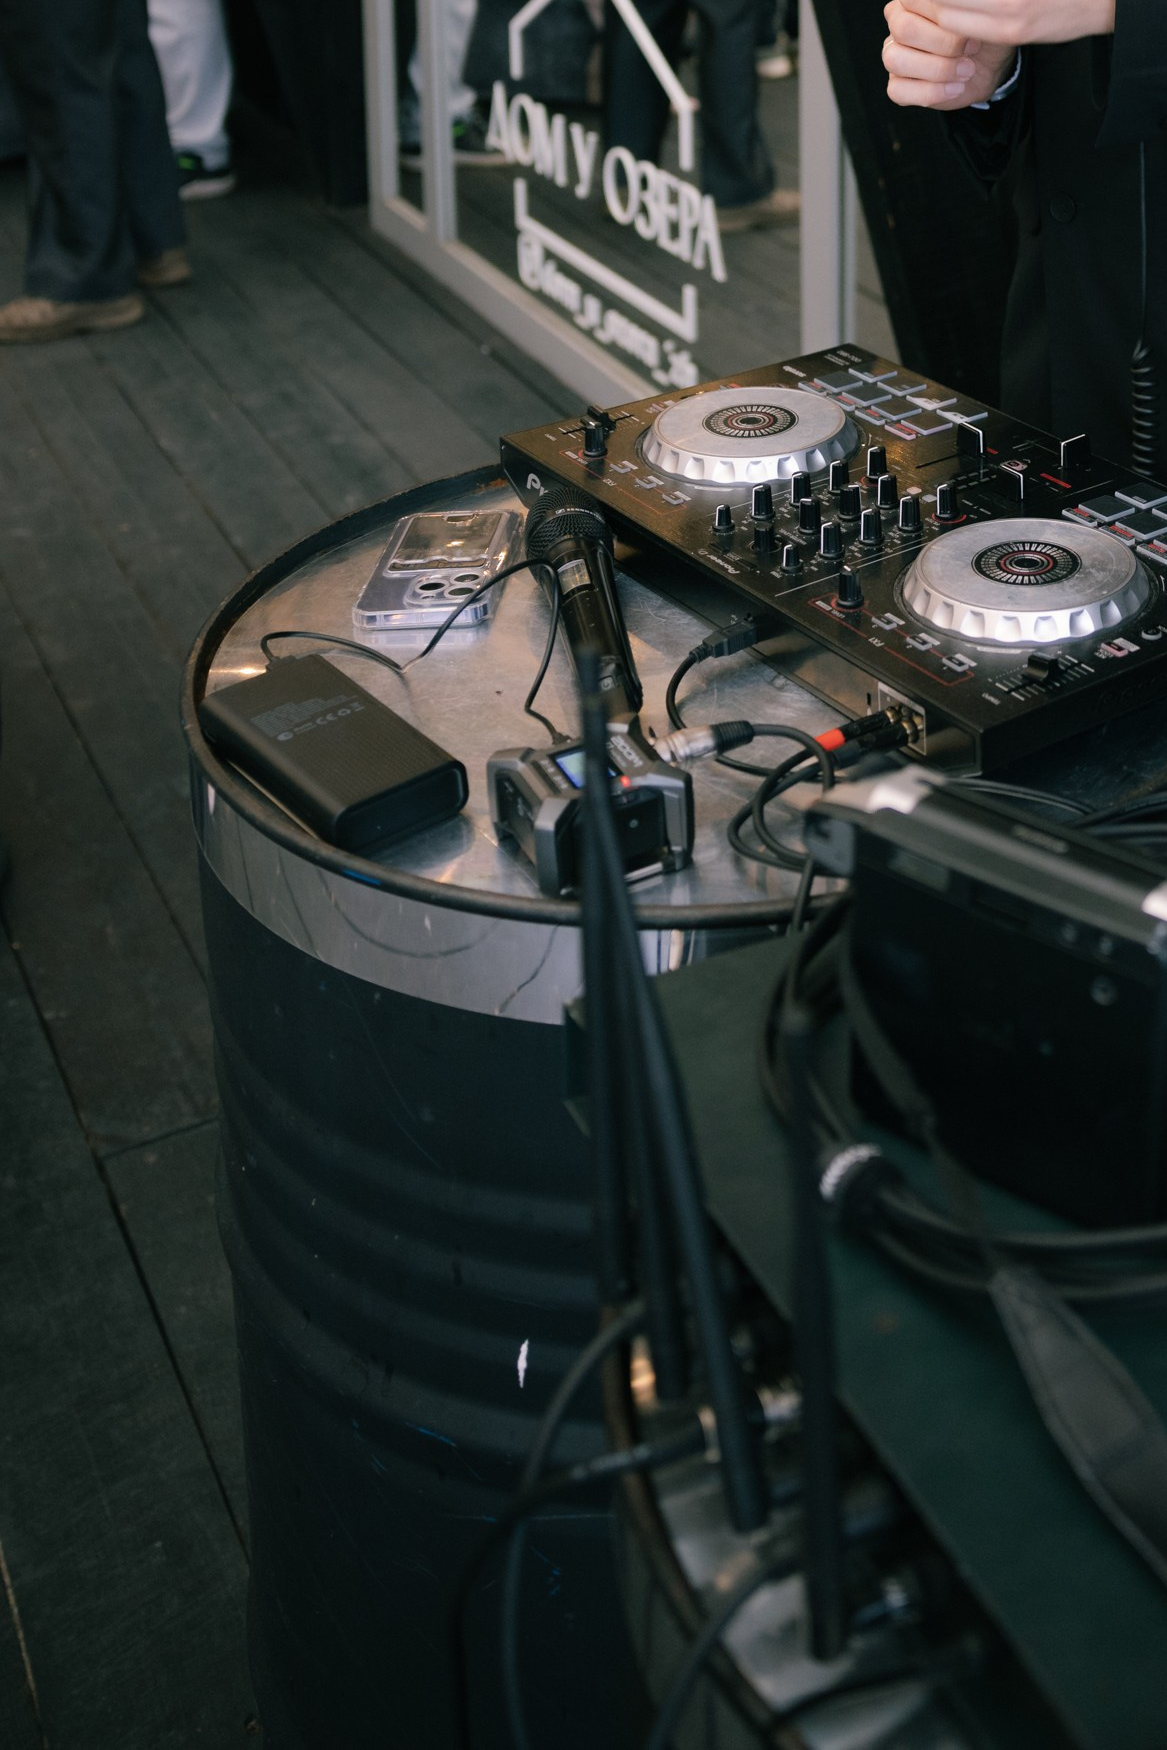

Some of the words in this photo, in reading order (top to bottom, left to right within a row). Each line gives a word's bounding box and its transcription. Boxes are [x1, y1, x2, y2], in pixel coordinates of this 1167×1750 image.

[486, 80, 569, 188] ДОМ
[570, 121, 599, 200] У
[603, 146, 728, 283] ОЗЕРА
[707, 554, 739, 574] Pioneer
[868, 637, 884, 647] FX1
[610, 734, 644, 768] ZOOM
